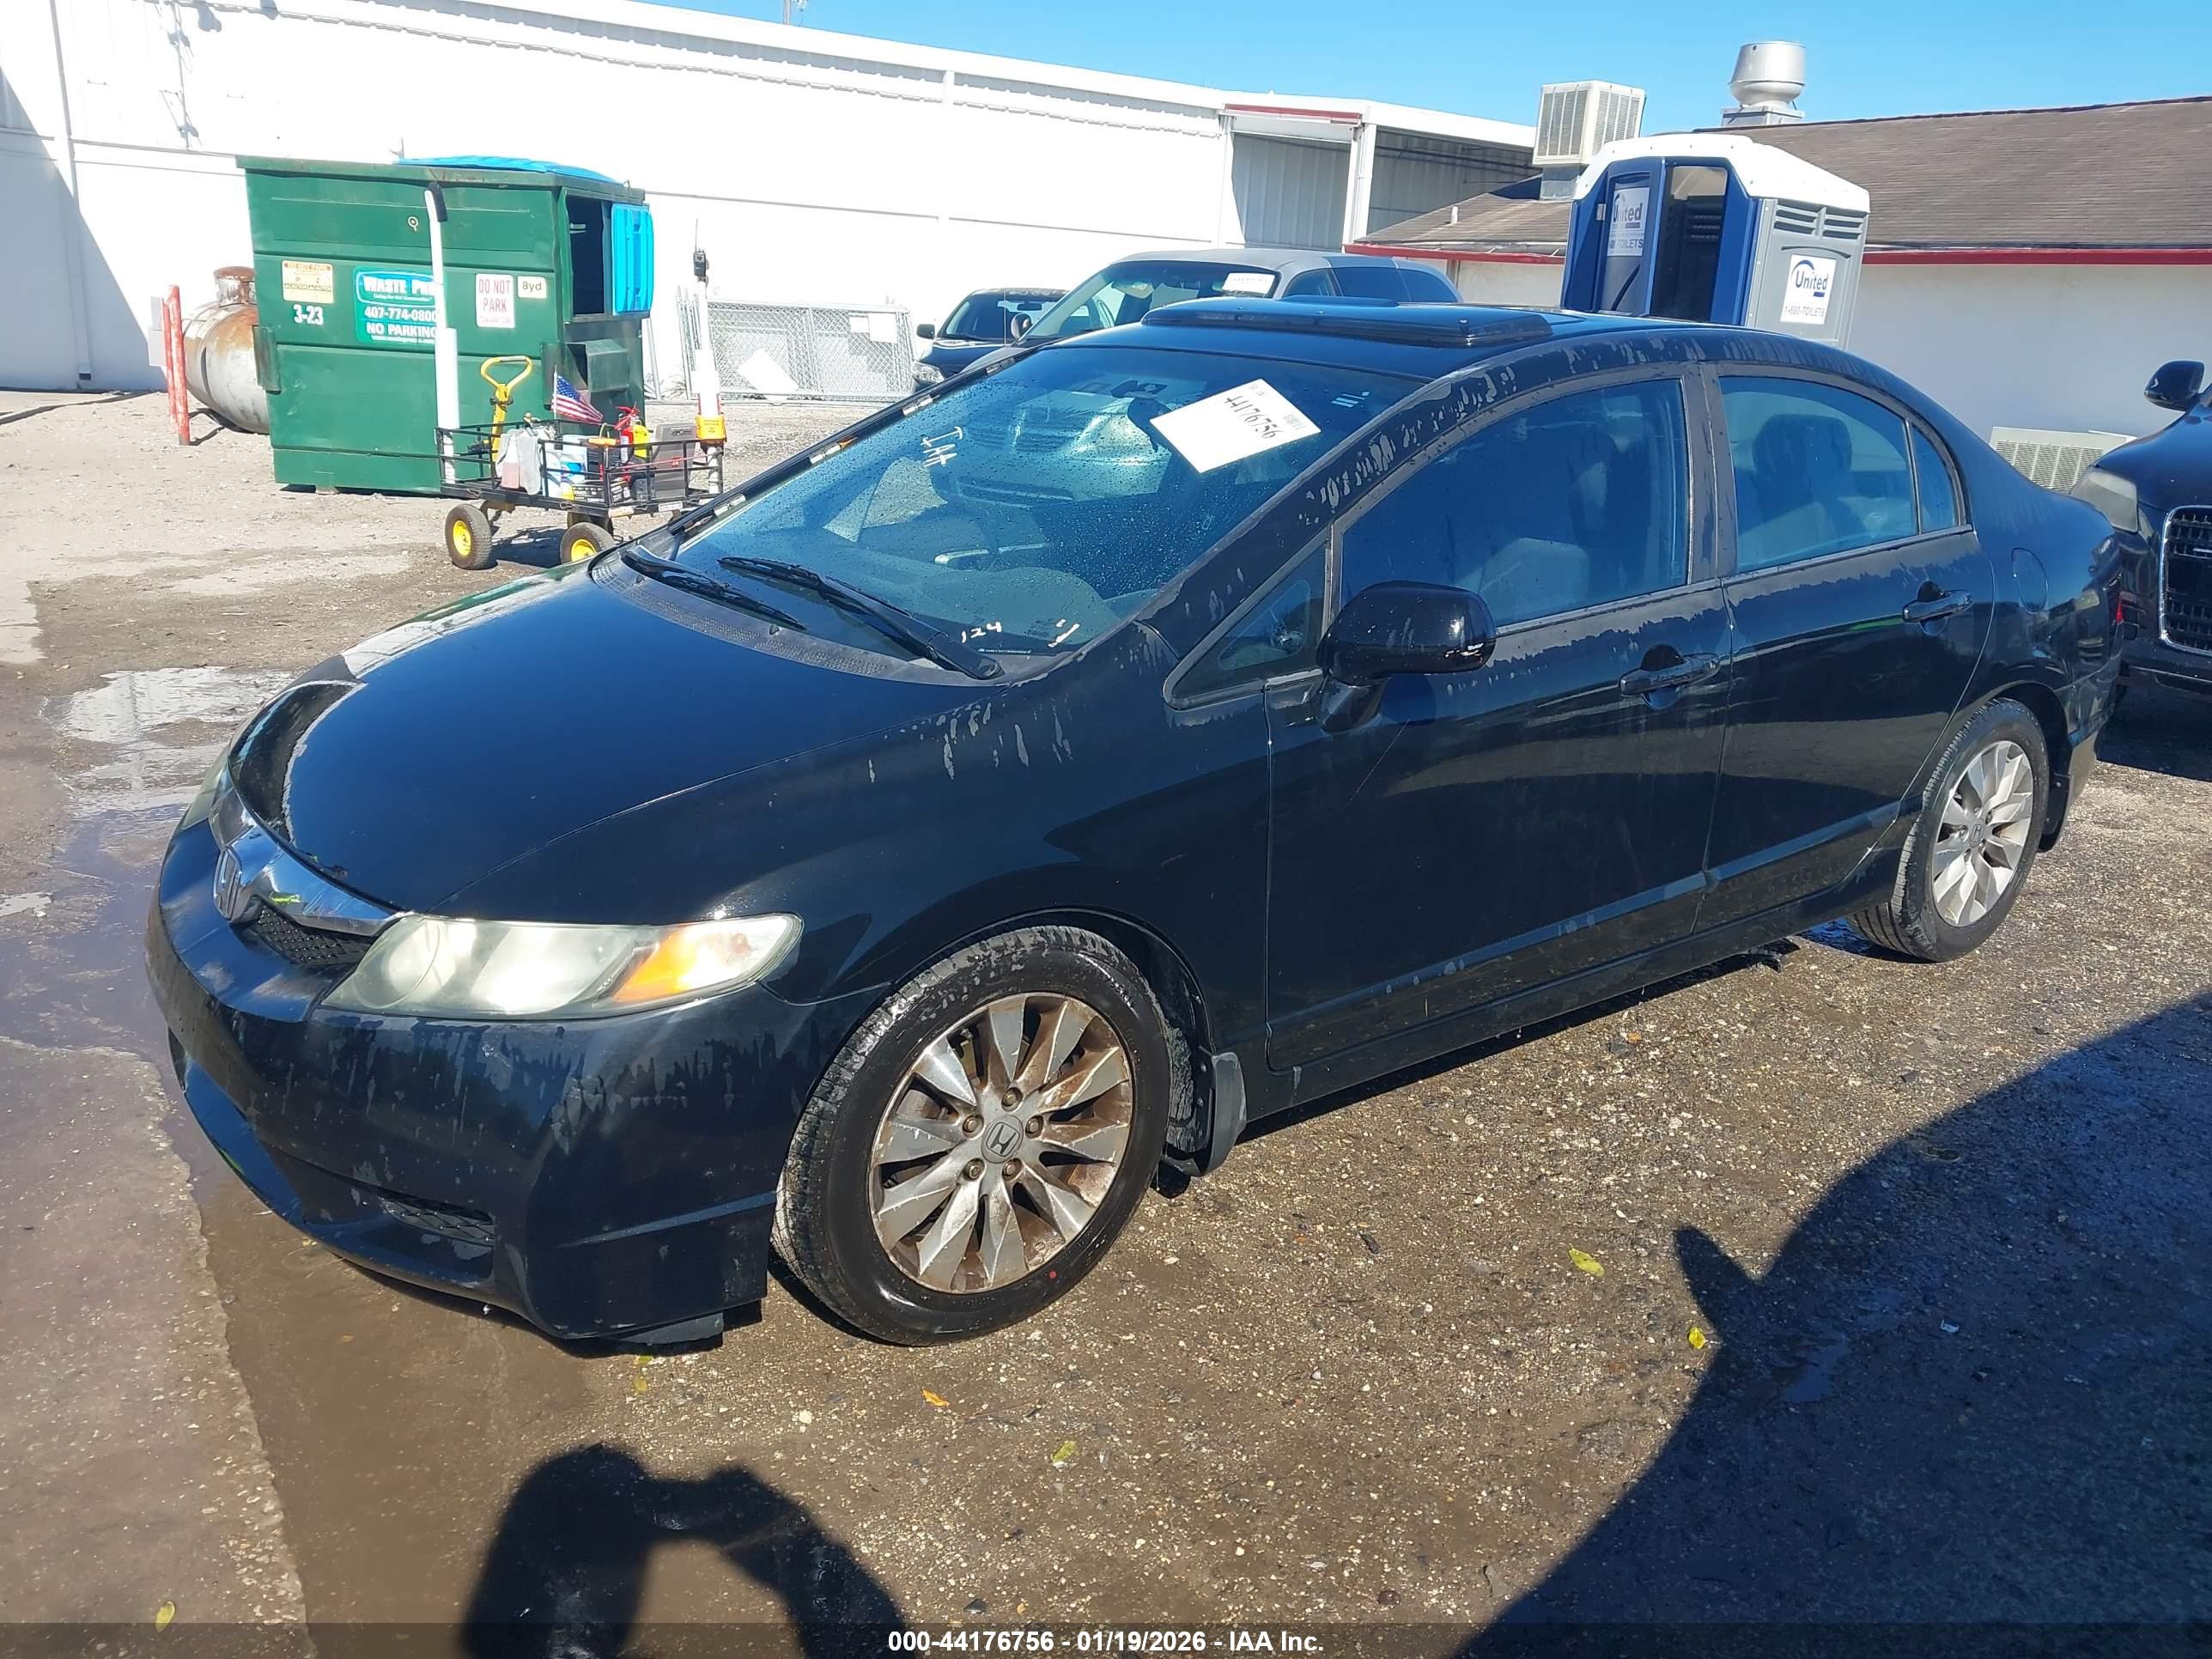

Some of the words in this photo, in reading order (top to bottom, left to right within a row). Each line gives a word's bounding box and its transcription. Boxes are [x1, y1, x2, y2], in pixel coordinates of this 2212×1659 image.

[363, 276, 407, 294] WASTE
[478, 279, 489, 294] DO
[494, 279, 510, 294] NOT
[522, 281, 542, 292] 8yd
[1796, 270, 1828, 290] United
[483, 297, 507, 313] PARK
[293, 304, 324, 325] 3-23
[366, 322, 385, 335] NO
[1224, 395, 1285, 439] 44176756
